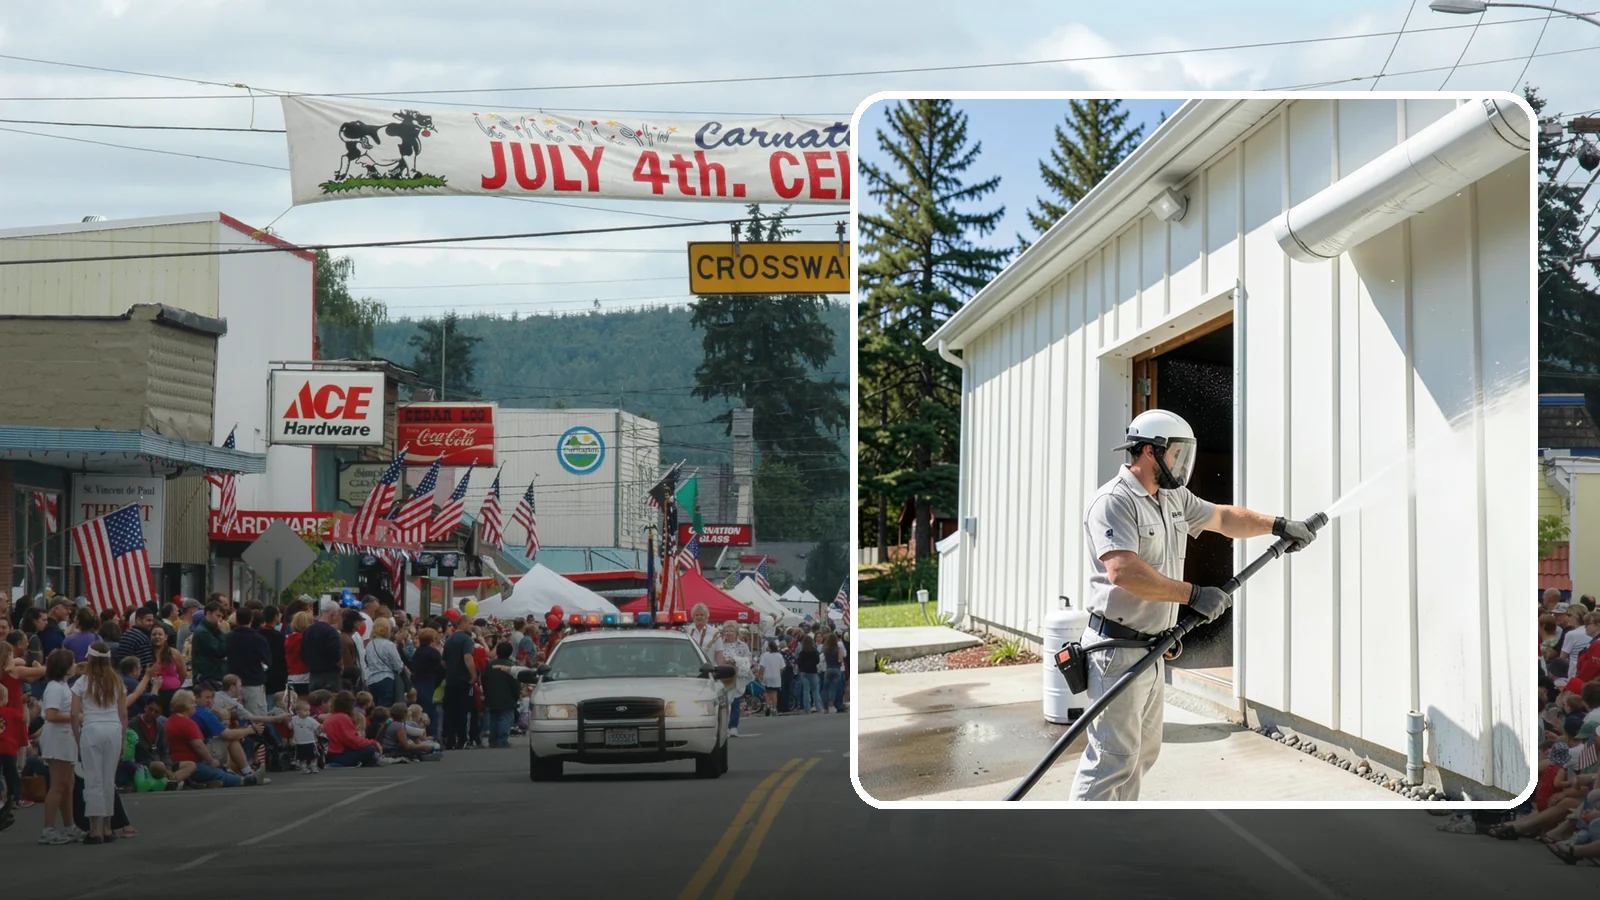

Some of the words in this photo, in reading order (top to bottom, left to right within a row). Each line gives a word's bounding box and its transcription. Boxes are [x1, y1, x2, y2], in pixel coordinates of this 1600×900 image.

[481, 141, 605, 192] JULY
[632, 149, 746, 198] 4th.
[697, 254, 850, 280] CROSSWA
[283, 380, 373, 420] ACE
[405, 409, 453, 422] CEDAR
[461, 409, 485, 421] LOG
[283, 421, 371, 437] Hardware
[416, 428, 477, 447] Coca-Cola
[83, 485, 93, 494] St.
[95, 485, 124, 495] Vincent
[126, 486, 136, 495] de
[137, 486, 155, 495] Paul
[688, 526, 741, 535] CRNATION
[699, 535, 730, 544] GLASS
